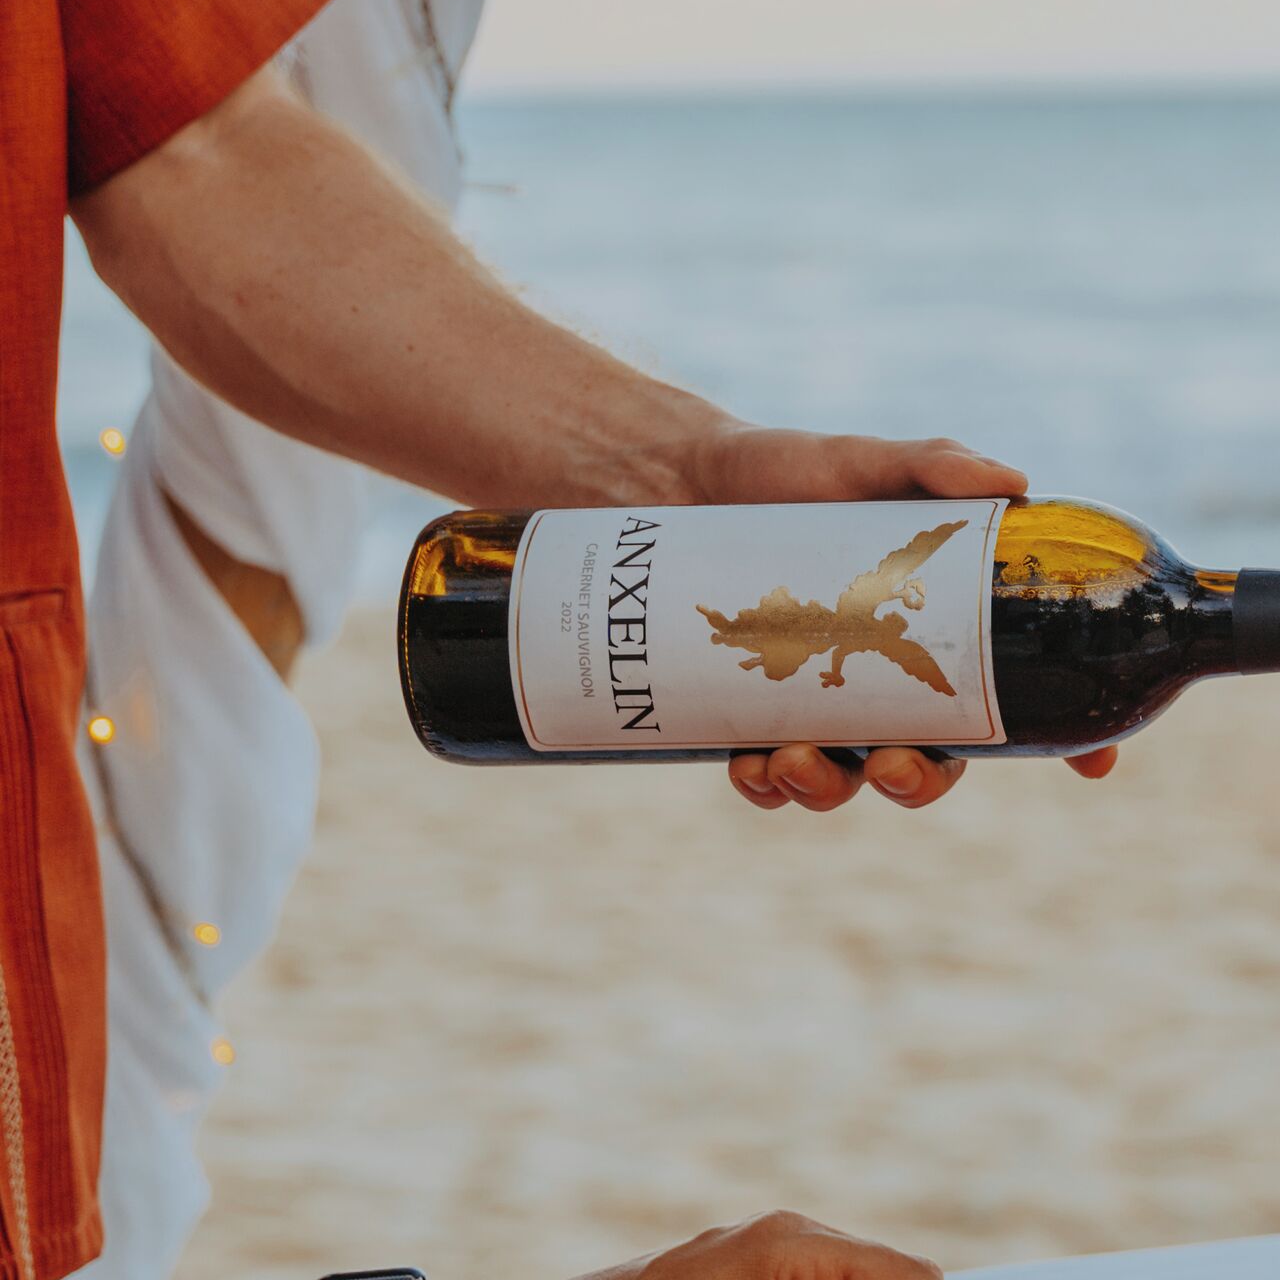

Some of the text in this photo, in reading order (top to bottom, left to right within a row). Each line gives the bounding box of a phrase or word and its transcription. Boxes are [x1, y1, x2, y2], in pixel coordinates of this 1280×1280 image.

[561, 601, 573, 633] 2022
[577, 543, 598, 698] CABERNET SAUVIGNON
[608, 516, 663, 733] ANXELIN
